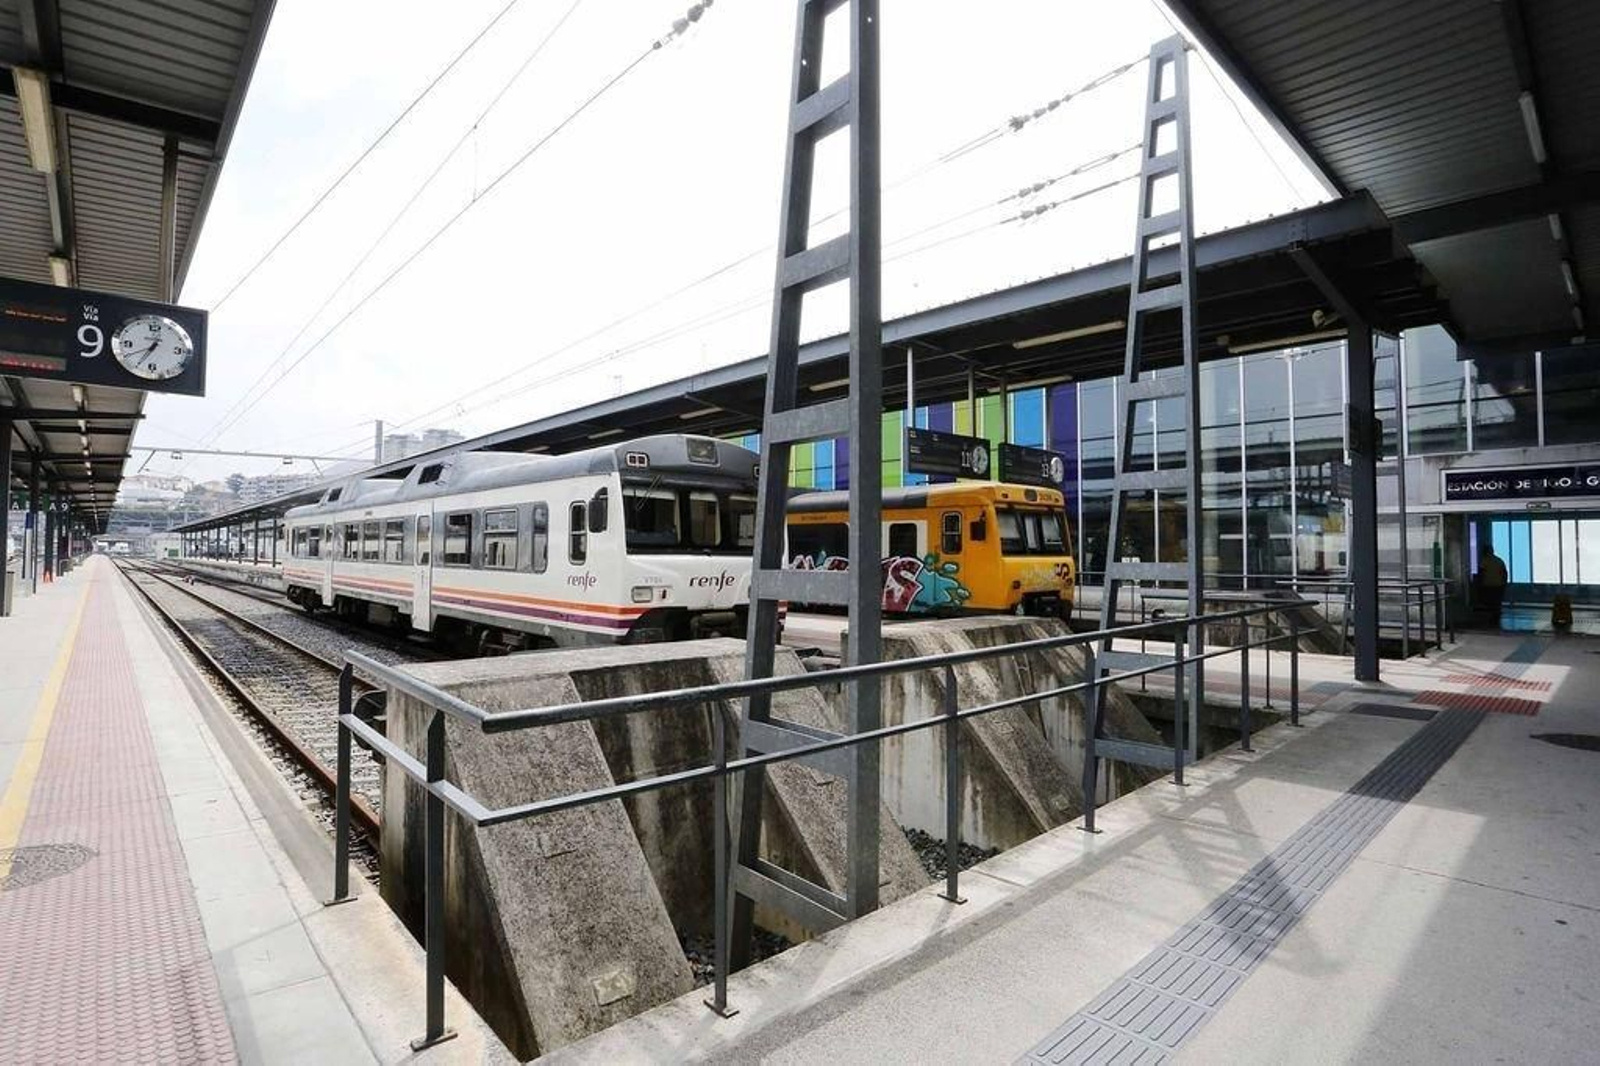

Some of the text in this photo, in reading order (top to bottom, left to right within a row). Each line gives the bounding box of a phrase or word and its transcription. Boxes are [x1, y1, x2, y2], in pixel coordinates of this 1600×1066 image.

[77, 324, 104, 358] 9
[567, 571, 598, 593] renfe
[689, 569, 736, 593] renfe
